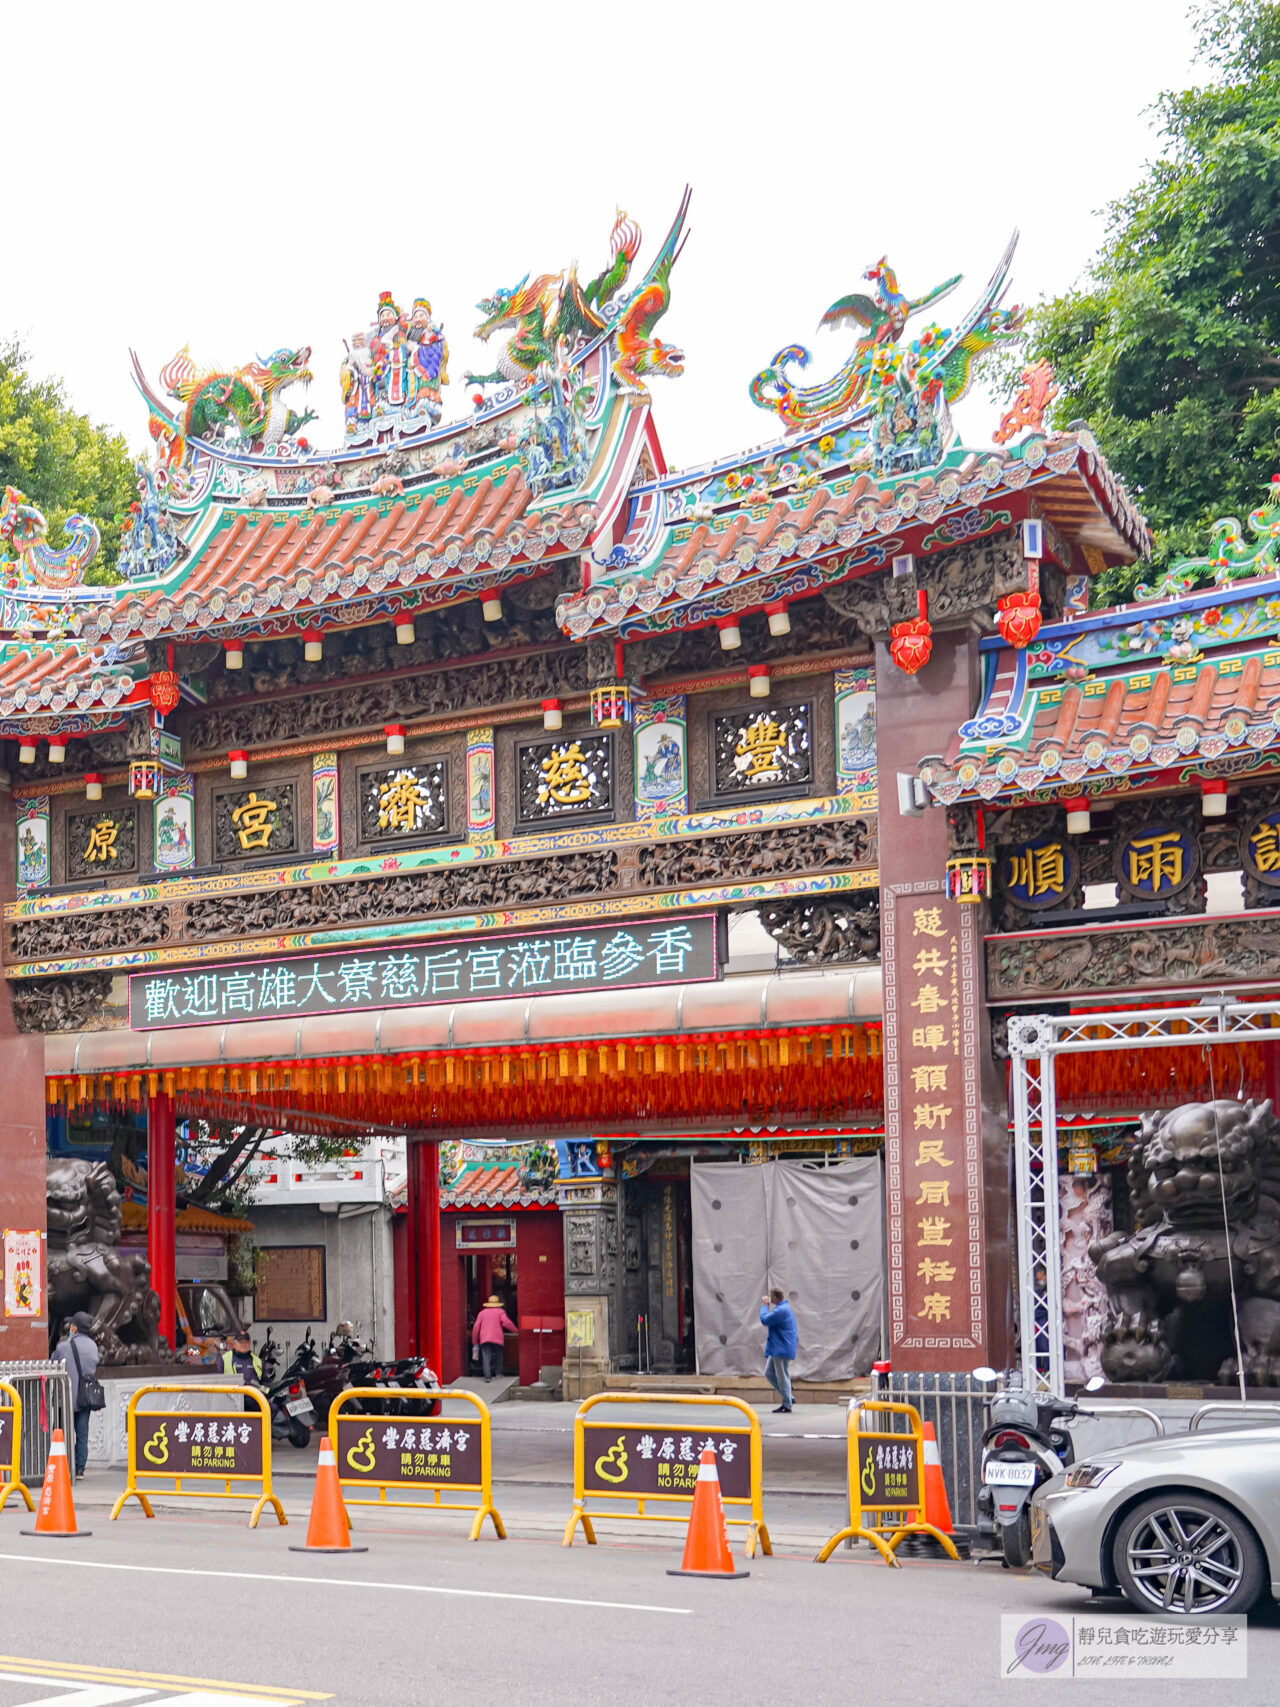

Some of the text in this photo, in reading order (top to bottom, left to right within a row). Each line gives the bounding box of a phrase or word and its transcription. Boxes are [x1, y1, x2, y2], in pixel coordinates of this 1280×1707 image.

[83, 720, 786, 862] 原 宮 濟 慈 豐
[1008, 842, 1065, 897] 順
[1128, 831, 1183, 893] 雨
[143, 925, 695, 1022] 歡迎高雄大寮慈后宮蒞臨參香
[174, 1421, 252, 1445] 豐原慈濟宮
[382, 1426, 470, 1452] 豐原慈濟宮
[191, 1445, 235, 1458] 請勿停車
[876, 1444, 914, 1471] 豐原慈濟宮
[191, 1457, 235, 1468] NO PARKING
[401, 1453, 451, 1466] 請勿停車
[401, 1467, 451, 1478] NO PARKING
[657, 1463, 699, 1477] 請勿停
[987, 1468, 1032, 1480] NVK-8037
[658, 1477, 697, 1489] NO PARK
